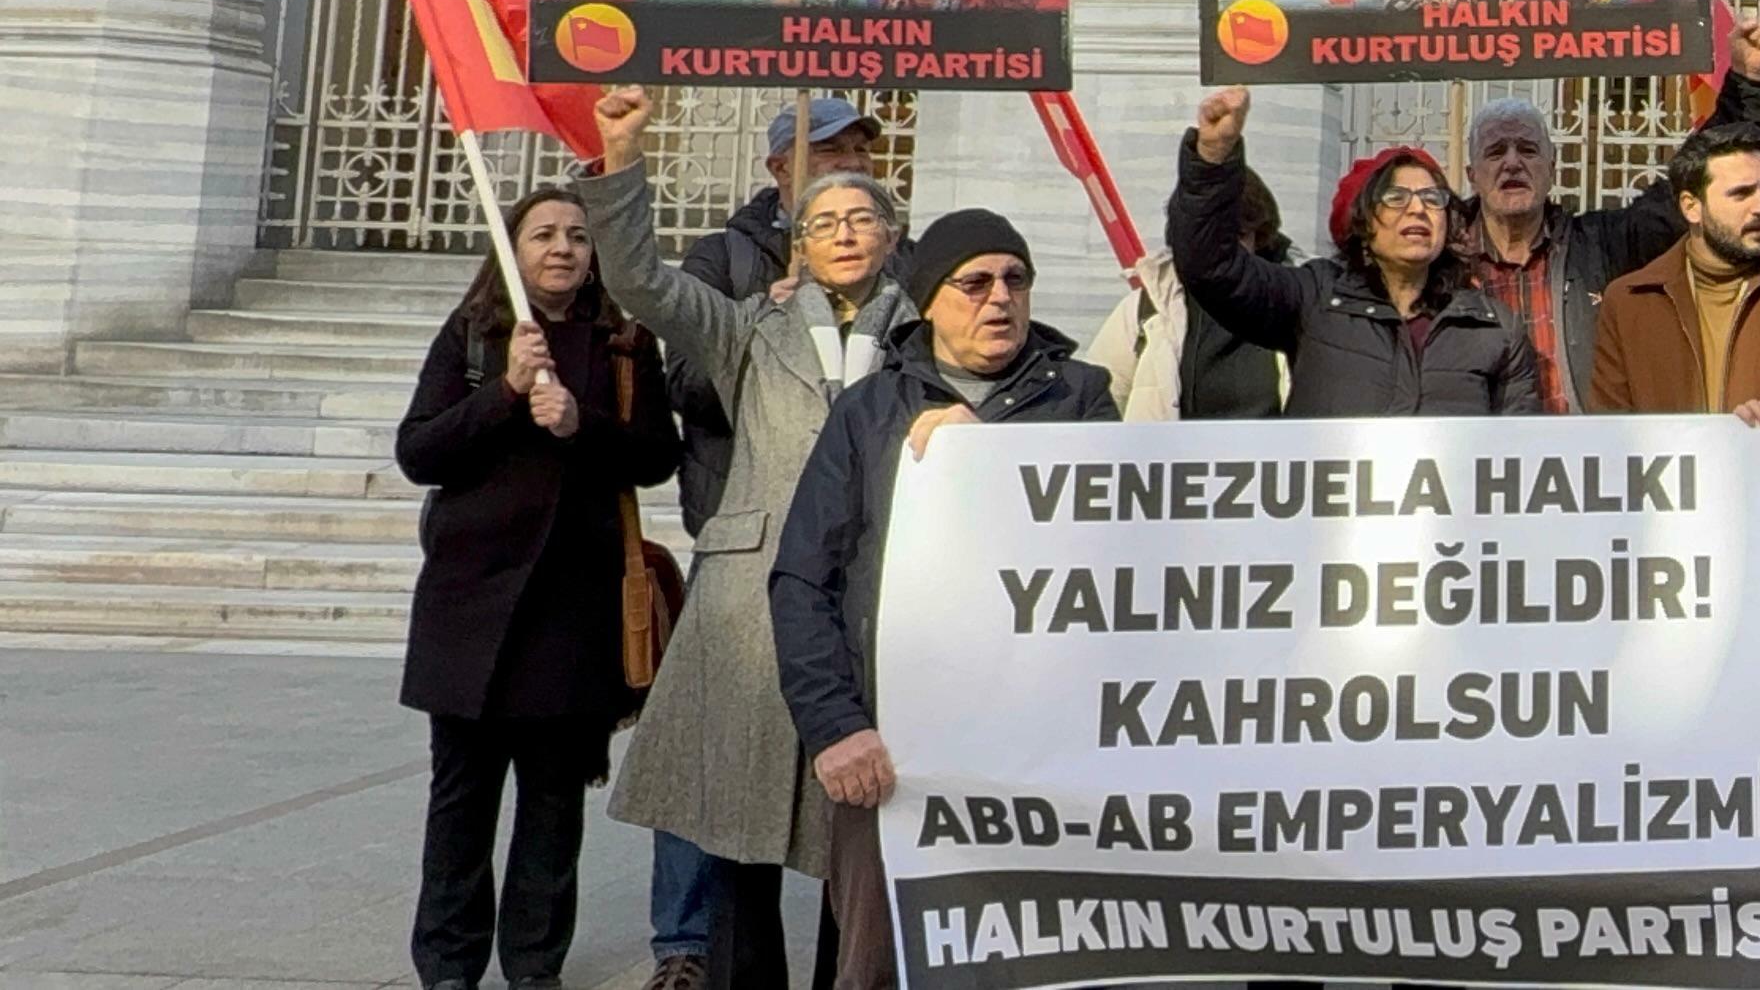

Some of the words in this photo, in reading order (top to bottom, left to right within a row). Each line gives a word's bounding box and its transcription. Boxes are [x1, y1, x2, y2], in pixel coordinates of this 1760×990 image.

[782, 16, 932, 46] HALKIN
[1310, 32, 1522, 67] KURTULUŞ
[1533, 22, 1682, 59] PARTİSİ
[661, 48, 883, 84] KURTULUŞ
[894, 46, 1043, 79] PARTİSİ
[1018, 458, 1452, 523] VENEZUELA
[1474, 455, 1698, 516] HALKI
[998, 563, 1295, 635] YALNIZ
[1319, 538, 1712, 628] DEĞİLDİR!
[1097, 670, 1610, 750] KAHROLSUN
[916, 793, 1194, 853] ABD-AB
[922, 898, 1169, 968] HALKIN
[1181, 902, 1523, 969] KURTULUŞ
